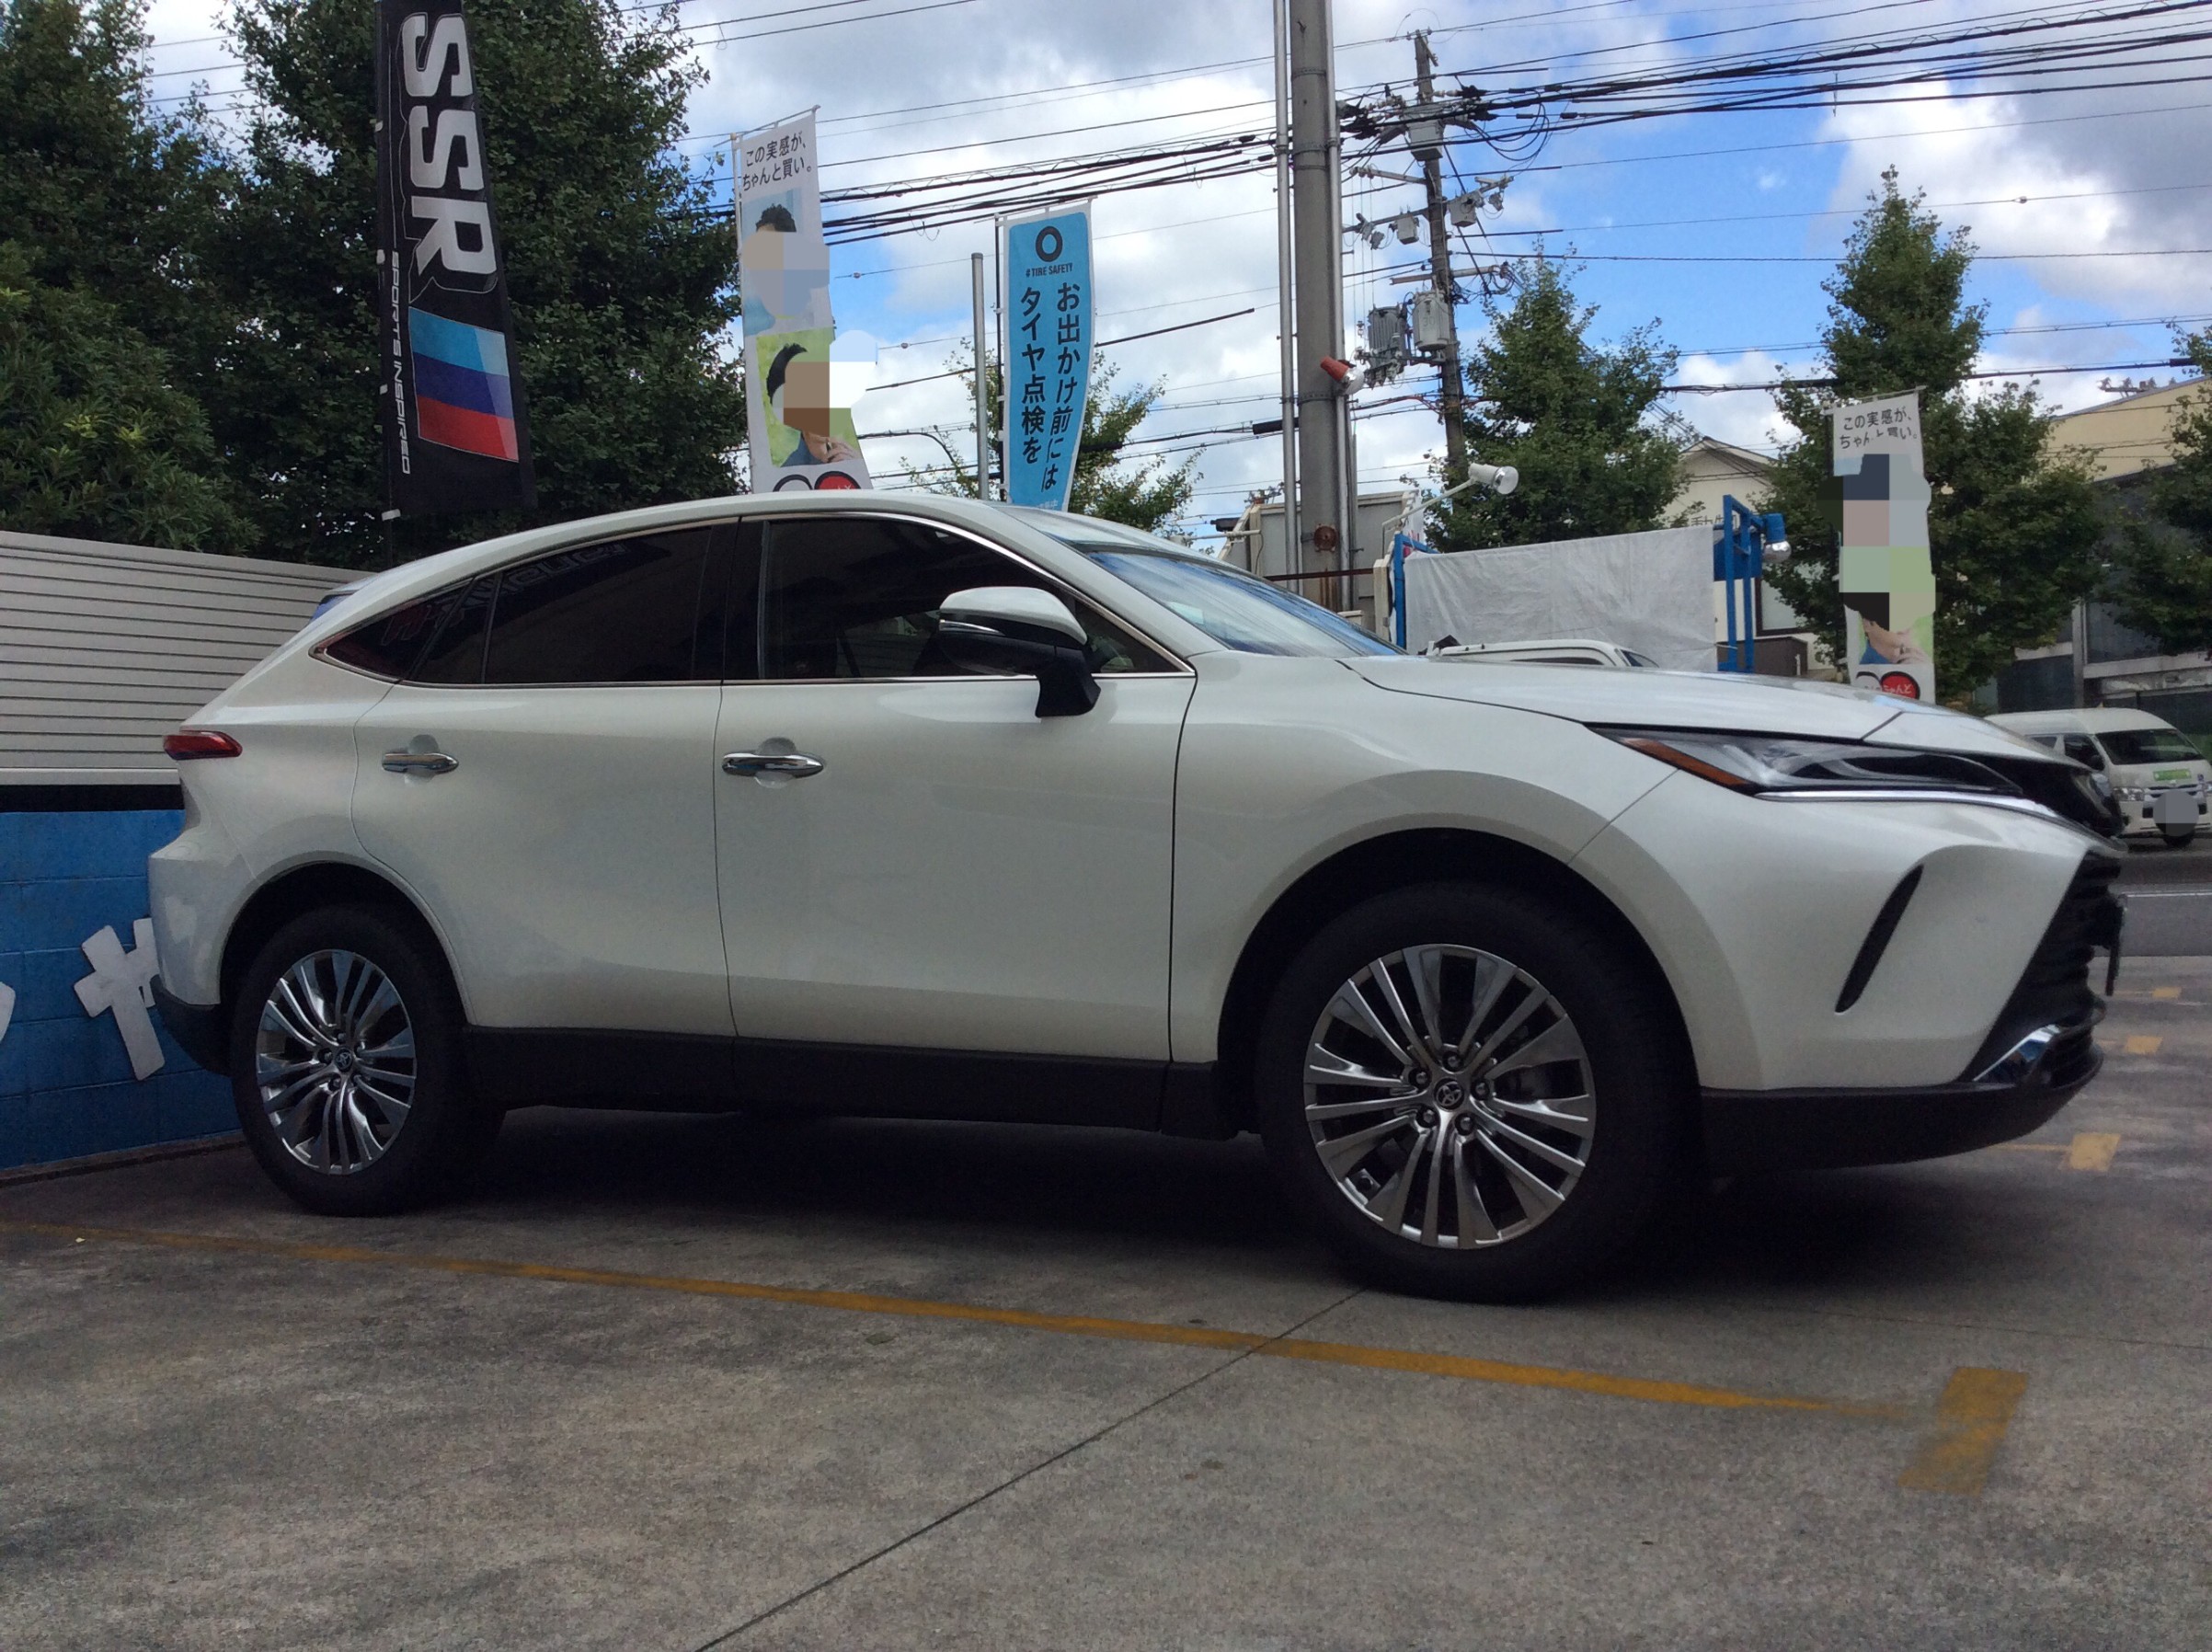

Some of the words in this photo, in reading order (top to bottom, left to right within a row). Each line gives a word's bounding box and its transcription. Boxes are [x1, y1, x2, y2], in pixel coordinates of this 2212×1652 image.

[402, 14, 498, 276] SSR
[743, 156, 812, 191] ちゃんと買い。
[747, 131, 806, 166] この実感が、
[391, 250, 402, 358] SPORTS
[1049, 262, 1073, 275] SAFETY
[394, 360, 411, 475] INSPIRED
[1021, 287, 1046, 465] タイヤ点検を
[1040, 281, 1081, 492] お出かけ前には
[1843, 406, 1912, 430] この実感が、
